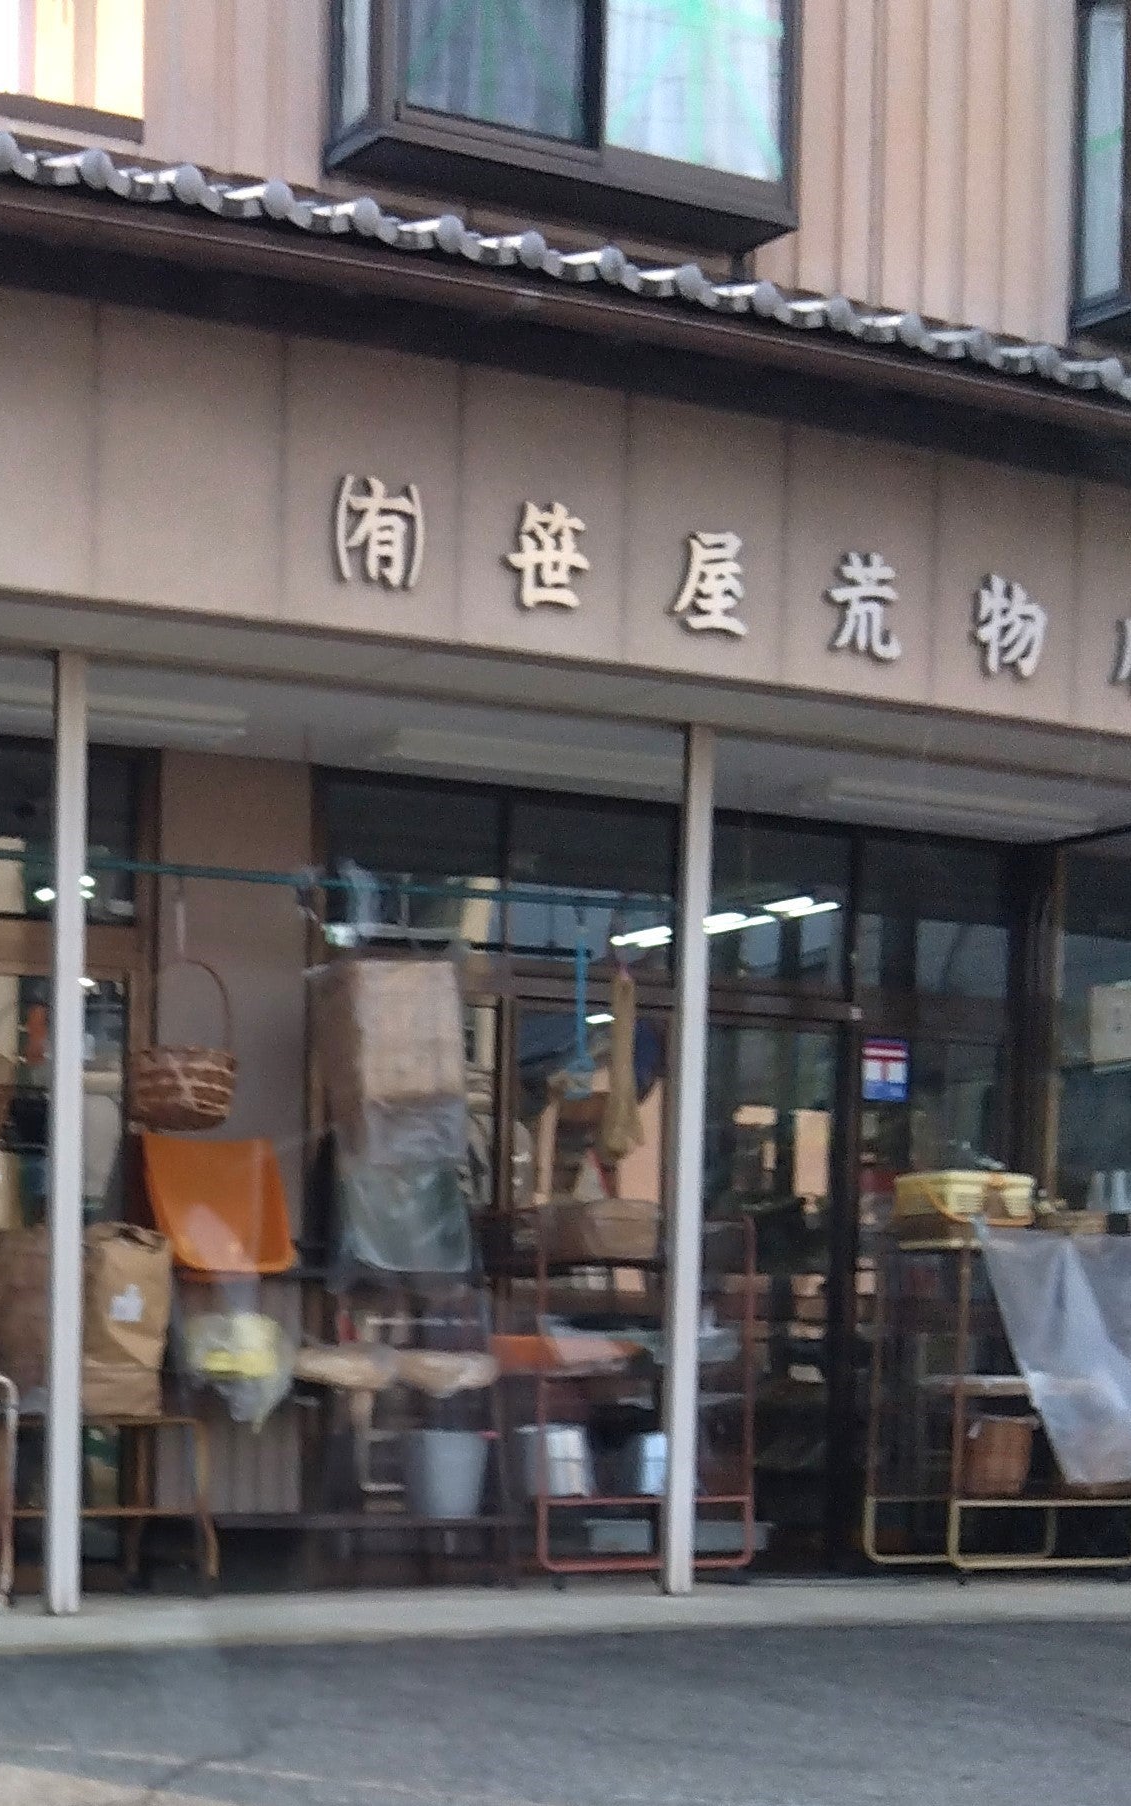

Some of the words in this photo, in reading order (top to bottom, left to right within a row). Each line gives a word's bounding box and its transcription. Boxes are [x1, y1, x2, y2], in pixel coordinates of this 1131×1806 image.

[336, 473, 1131, 681] (有)笹屋荒物
